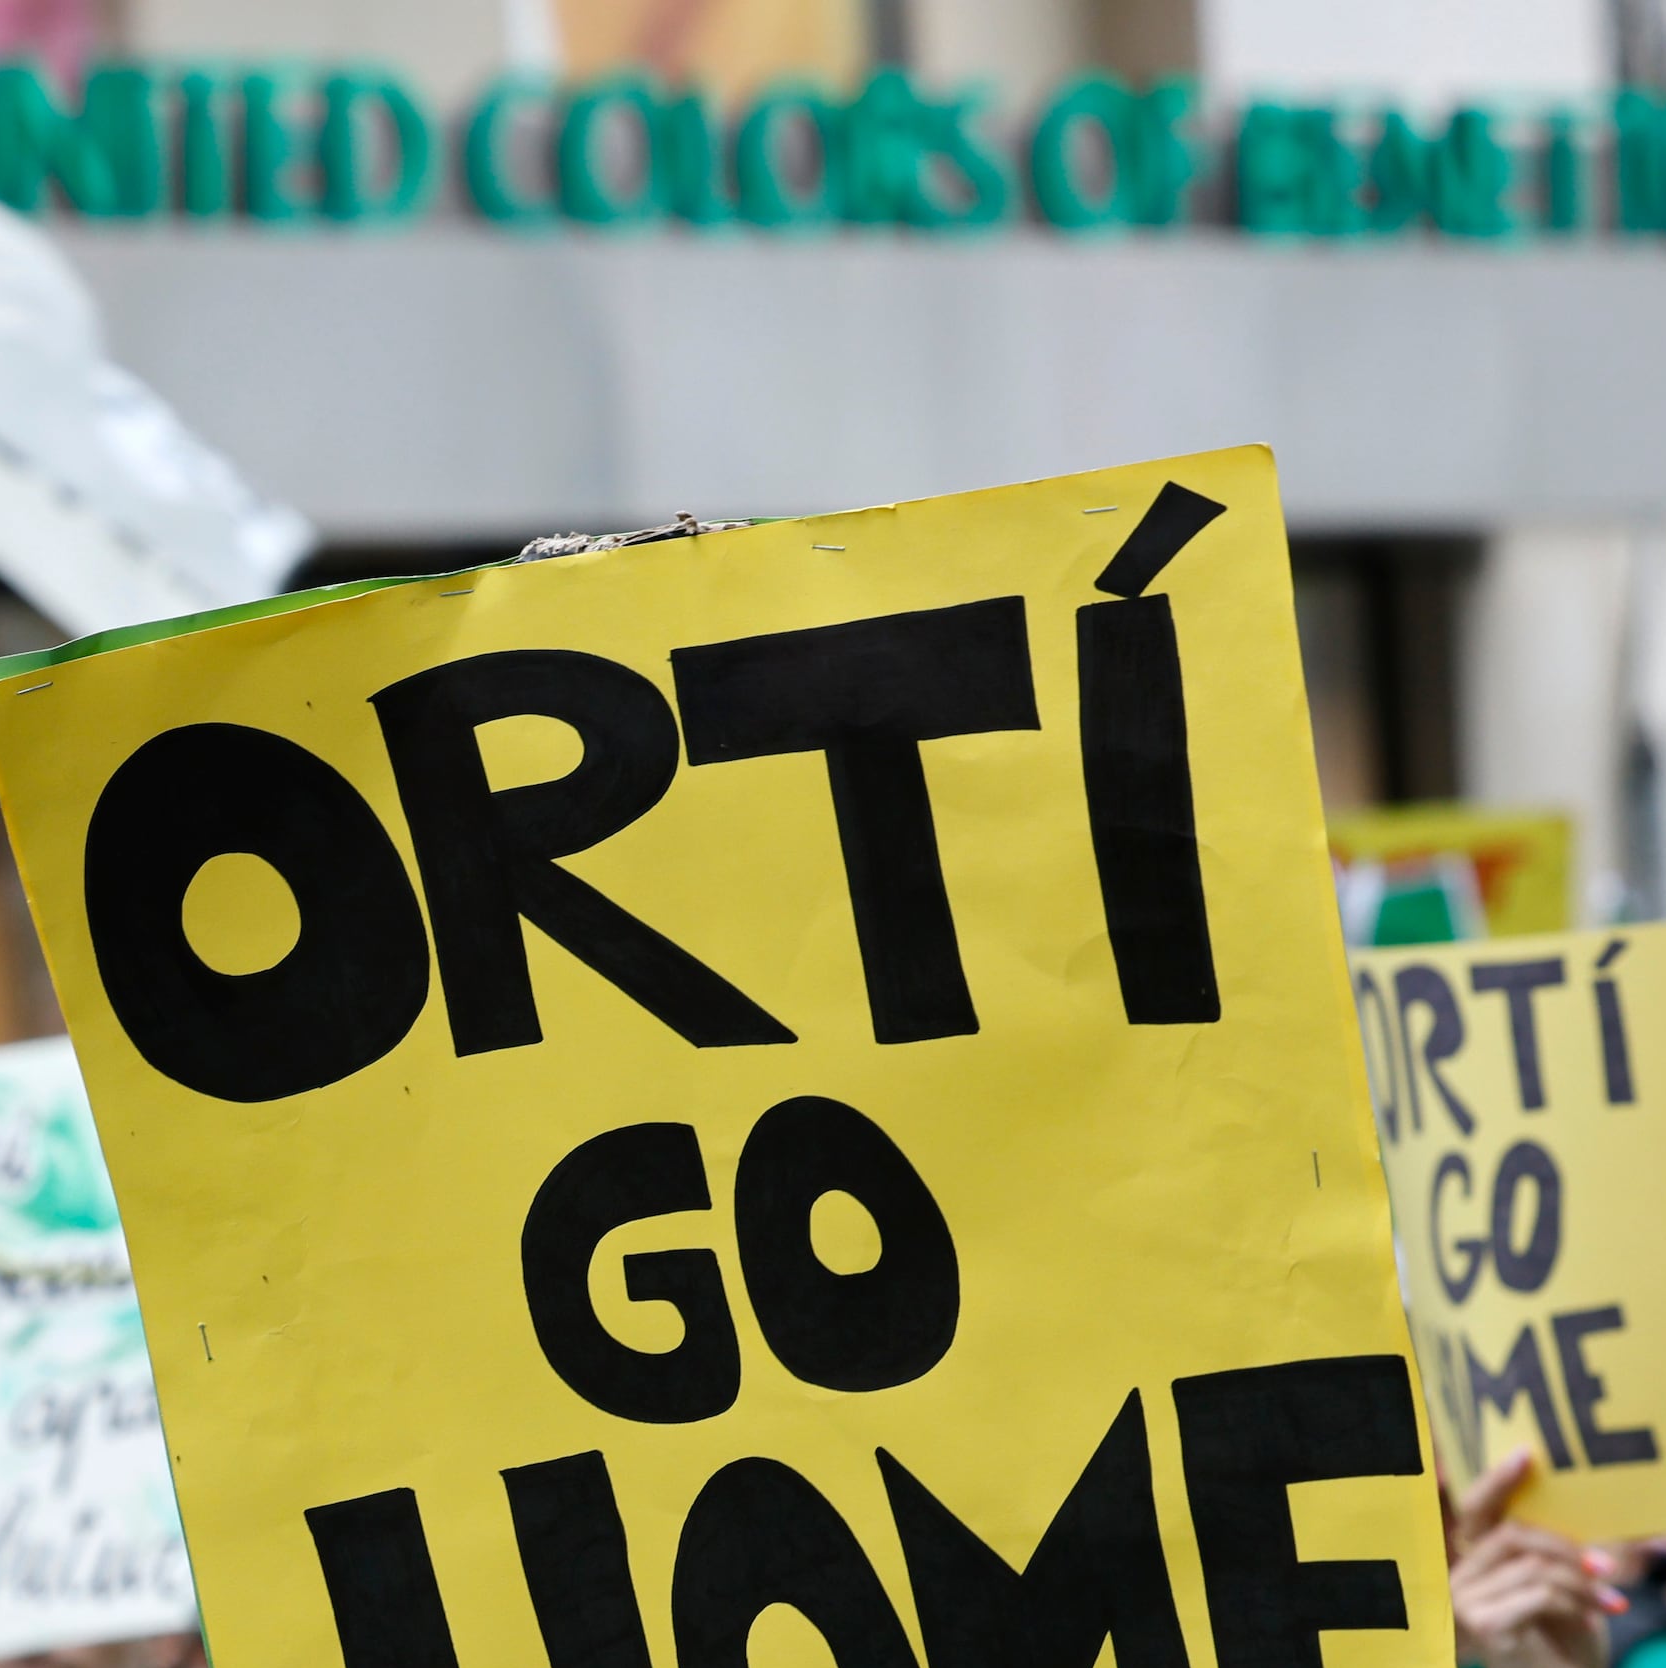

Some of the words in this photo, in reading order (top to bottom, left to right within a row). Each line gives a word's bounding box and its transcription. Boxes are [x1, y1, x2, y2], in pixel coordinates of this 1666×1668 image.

[1032, 70, 1195, 232] OF
[83, 481, 1227, 1103] ORTÍ
[521, 1095, 961, 1425] GO
[1429, 1140, 1563, 1306] GO
